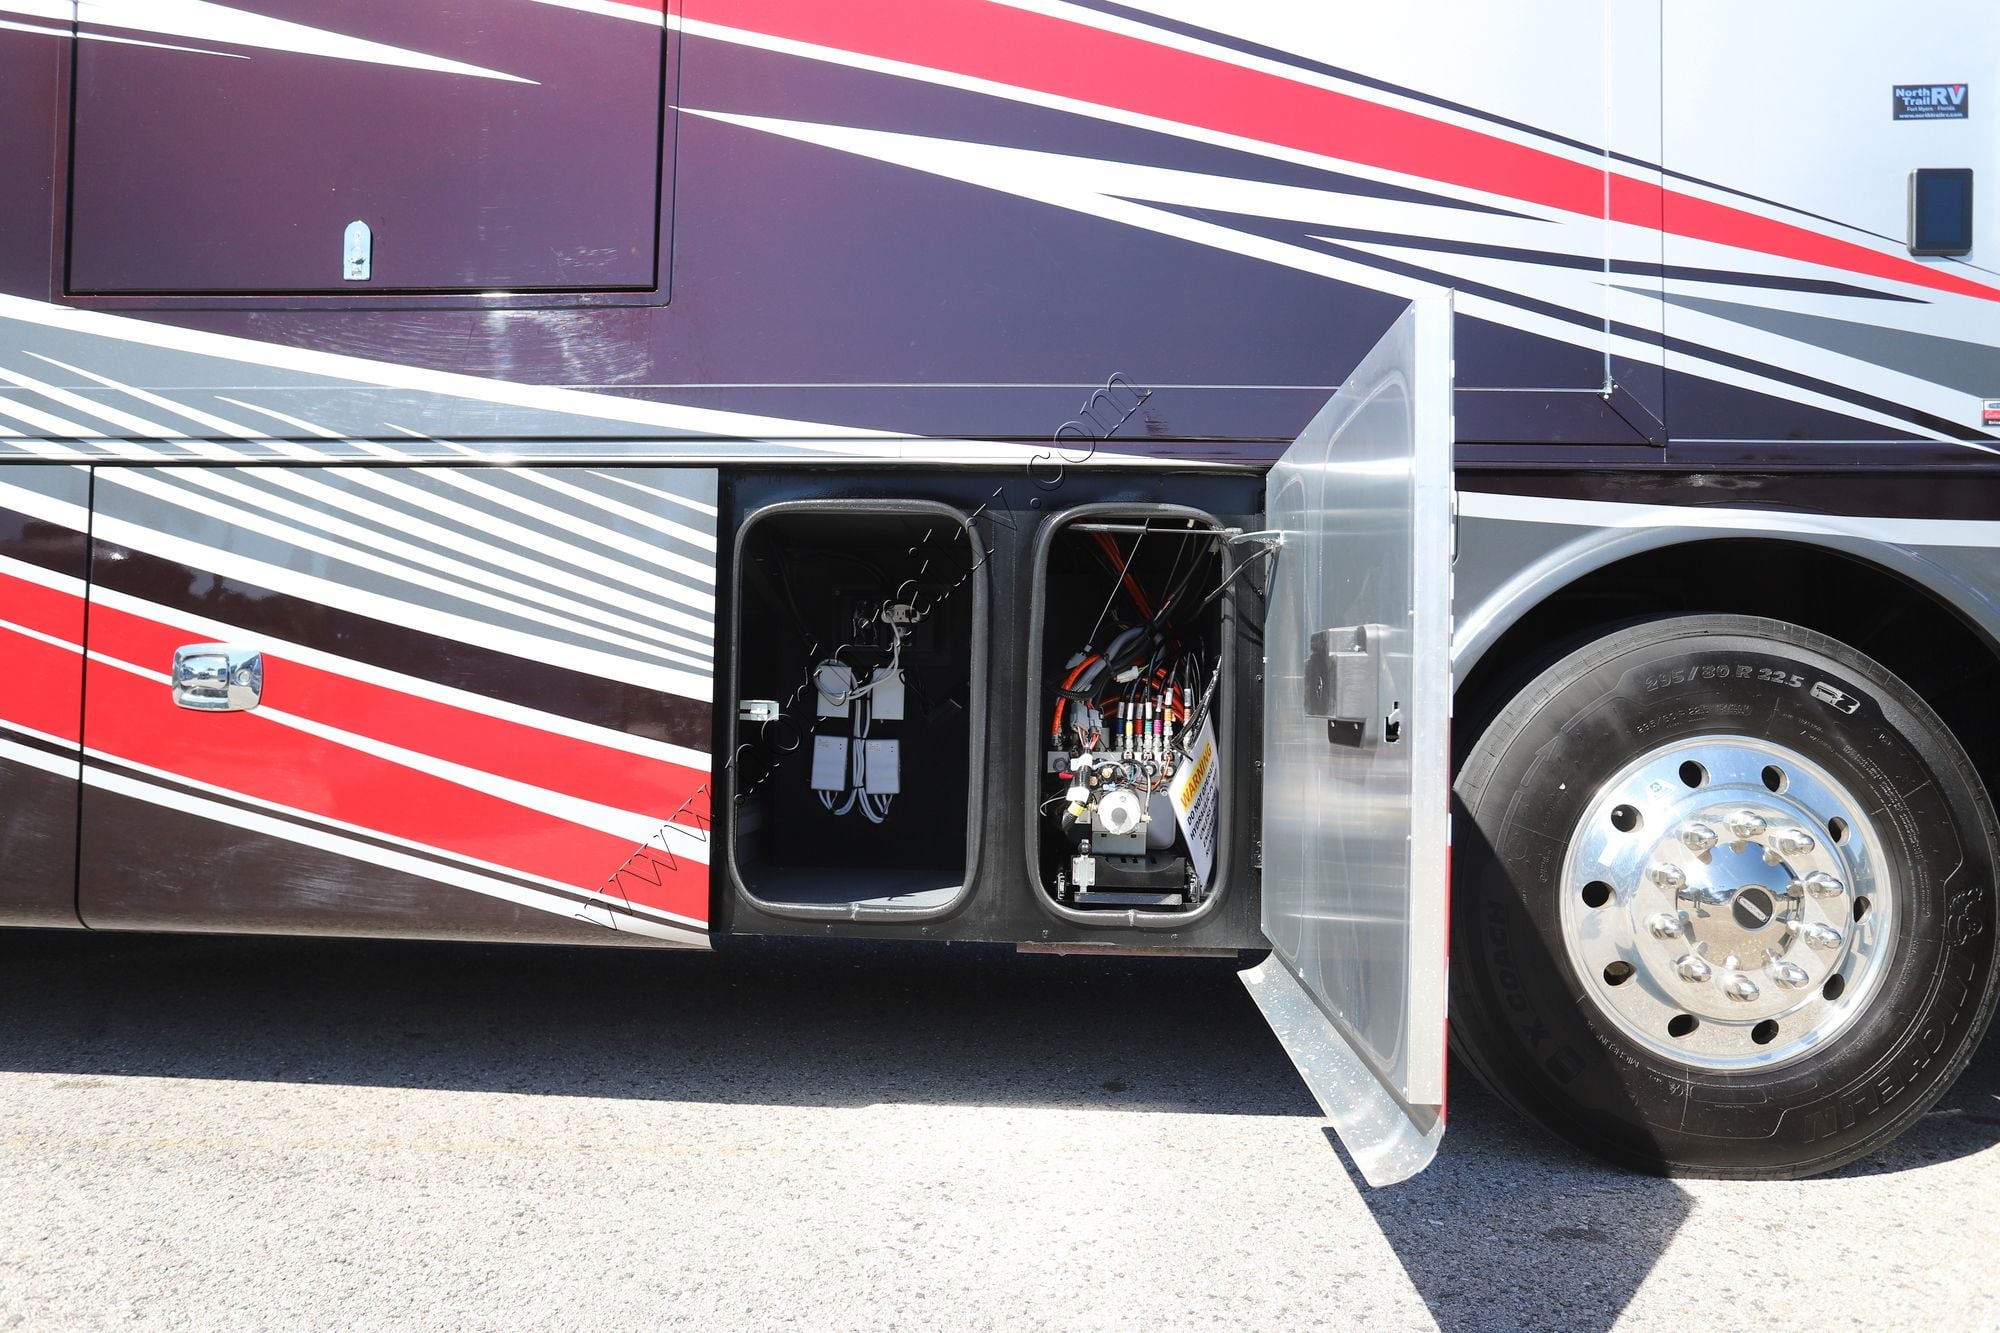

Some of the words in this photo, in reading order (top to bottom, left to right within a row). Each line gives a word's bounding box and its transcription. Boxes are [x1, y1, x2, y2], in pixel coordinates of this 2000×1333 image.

[1896, 88, 1930, 97] North
[1931, 87, 1966, 105] RV
[1902, 97, 1930, 105] Trail
[1735, 665, 1753, 679] R
[1757, 667, 1805, 688] 22.5
[1181, 743, 1212, 809] WARNING
[1187, 812, 1196, 826] DO
[1194, 794, 1203, 811] NOT
[1487, 899, 1527, 1012] COACH
